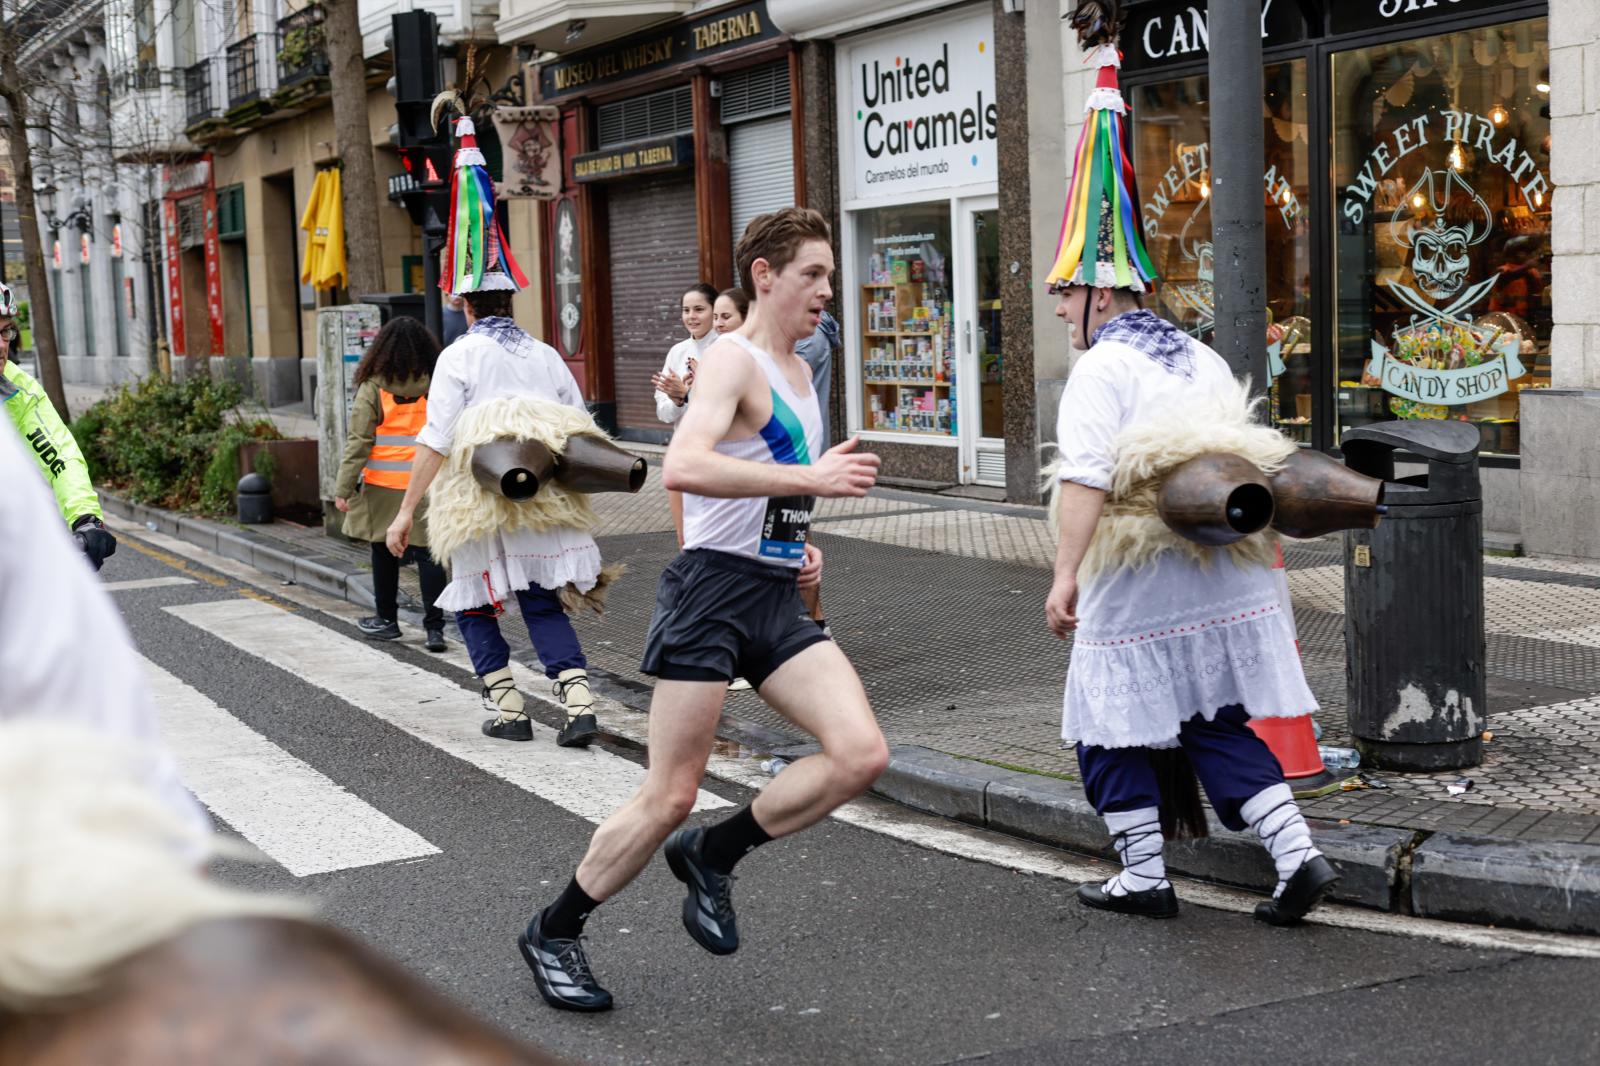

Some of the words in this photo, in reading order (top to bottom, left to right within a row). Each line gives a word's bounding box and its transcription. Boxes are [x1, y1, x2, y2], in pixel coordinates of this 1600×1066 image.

[554, 62, 594, 90] MUSEO
[597, 54, 620, 79] DEL
[622, 37, 673, 69] WHISKY
[693, 10, 761, 50] TABERNA
[862, 43, 949, 108] United
[639, 146, 672, 165] TABERNA
[864, 91, 998, 158] Caramels
[865, 164, 906, 184] Caramelos
[907, 163, 919, 178] del
[920, 160, 949, 176] mundo
[1143, 142, 1209, 239] SWEET
[1264, 164, 1301, 230] ATE
[1344, 114, 1430, 225] SWEET
[1440, 110, 1549, 212] PIRATE
[169, 245, 180, 320] SPAR
[207, 238, 219, 318] SPAR
[1388, 366, 1450, 400] CANDY
[1456, 367, 1502, 398] SHOP
[795, 529, 807, 542] 26
